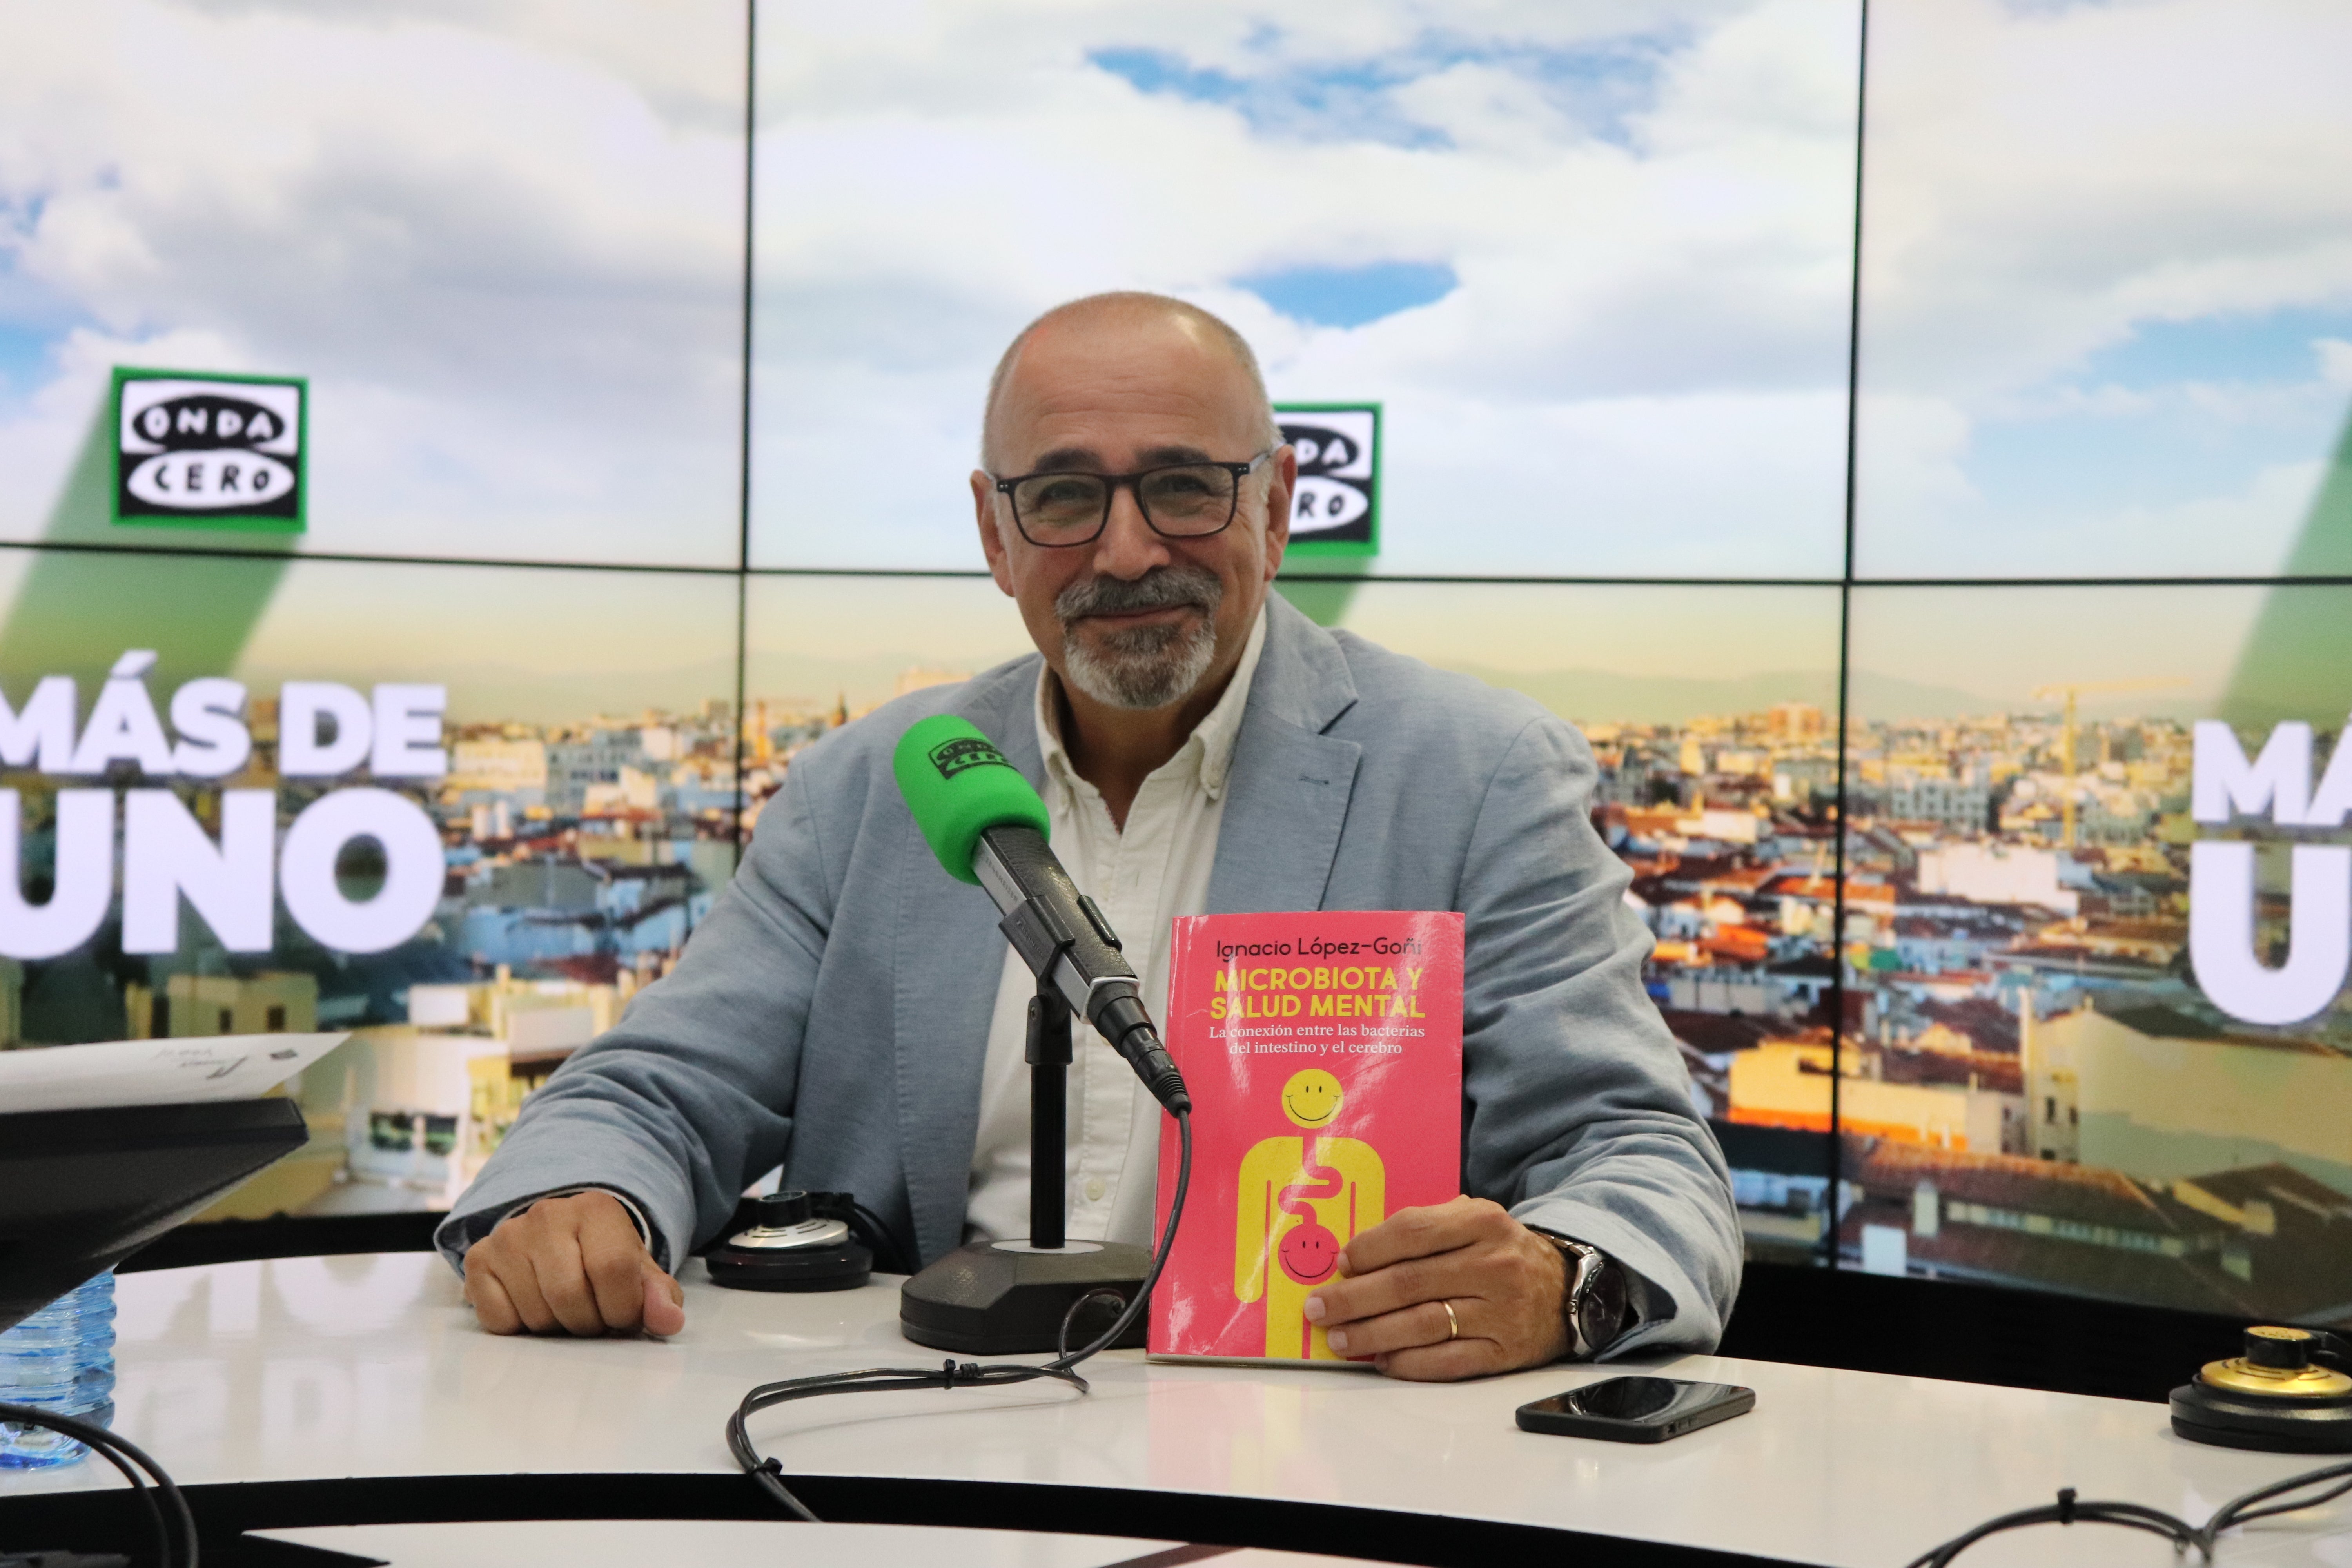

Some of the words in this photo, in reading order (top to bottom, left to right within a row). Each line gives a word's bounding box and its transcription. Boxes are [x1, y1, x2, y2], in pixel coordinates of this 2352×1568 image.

[144, 405, 273, 439] ONDA
[1294, 438, 1349, 466] DA
[154, 463, 270, 492] CERO
[1297, 492, 1345, 519] RO
[0, 649, 251, 777] MÁS
[278, 681, 447, 776] DE
[0, 787, 446, 959] UNO
[1216, 940, 1292, 963] Ignacio
[1298, 936, 1421, 960] López-Goñi
[1214, 967, 1399, 993] MICROBIOTA
[1406, 967, 1424, 990] Y
[1210, 994, 1301, 1020] SALUD
[1310, 994, 1426, 1018] MENTAL
[1209, 1027, 1227, 1038] La
[1230, 1024, 1293, 1038] conexión
[1296, 1025, 1334, 1036] entre
[1337, 1024, 1357, 1036] las
[1361, 1024, 1425, 1037] bacterias
[1229, 1042, 1251, 1054] del
[1254, 1041, 1317, 1053] intestino
[1319, 1044, 1330, 1056] y
[1332, 1040, 1345, 1053] el
[1348, 1041, 1403, 1054] cerebro
